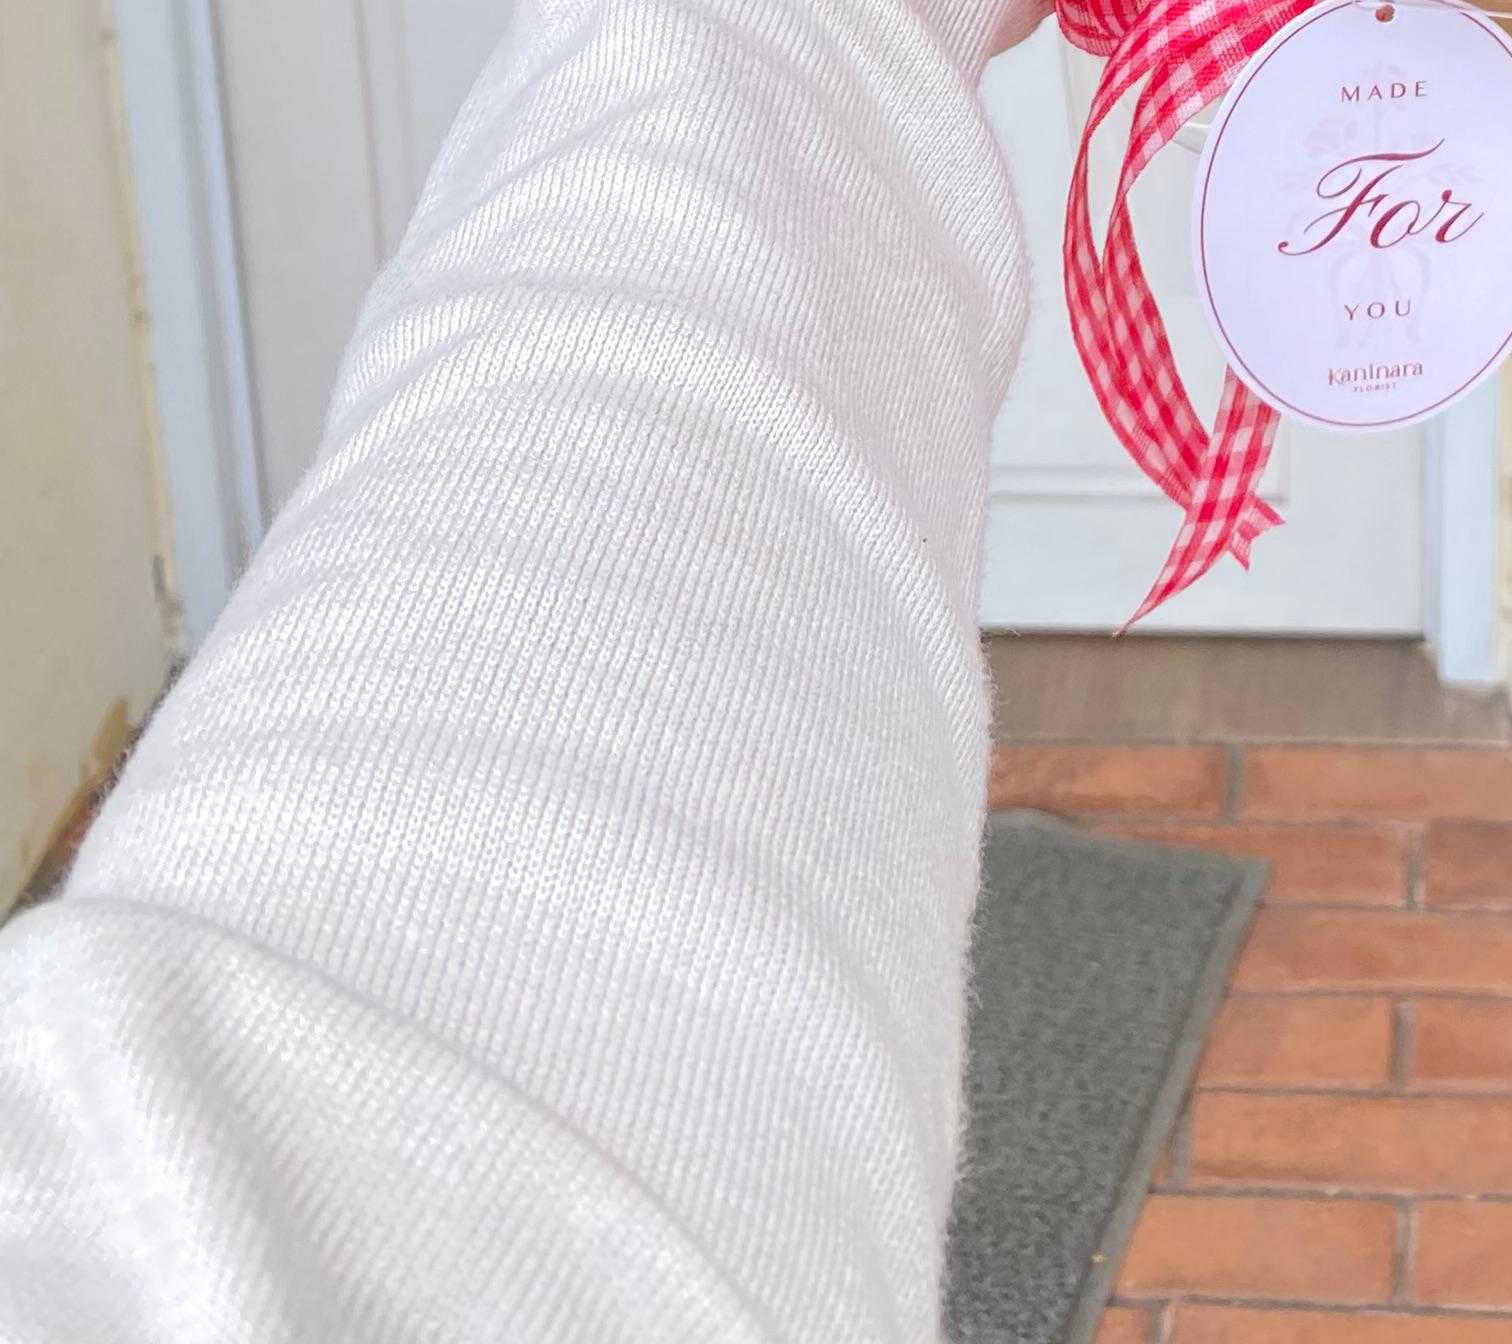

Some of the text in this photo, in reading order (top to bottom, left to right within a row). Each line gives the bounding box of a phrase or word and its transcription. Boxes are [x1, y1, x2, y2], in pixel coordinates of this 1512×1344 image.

[1341, 80, 1428, 103] MADE
[1277, 137, 1485, 256] For
[1343, 298, 1411, 321] YOU
